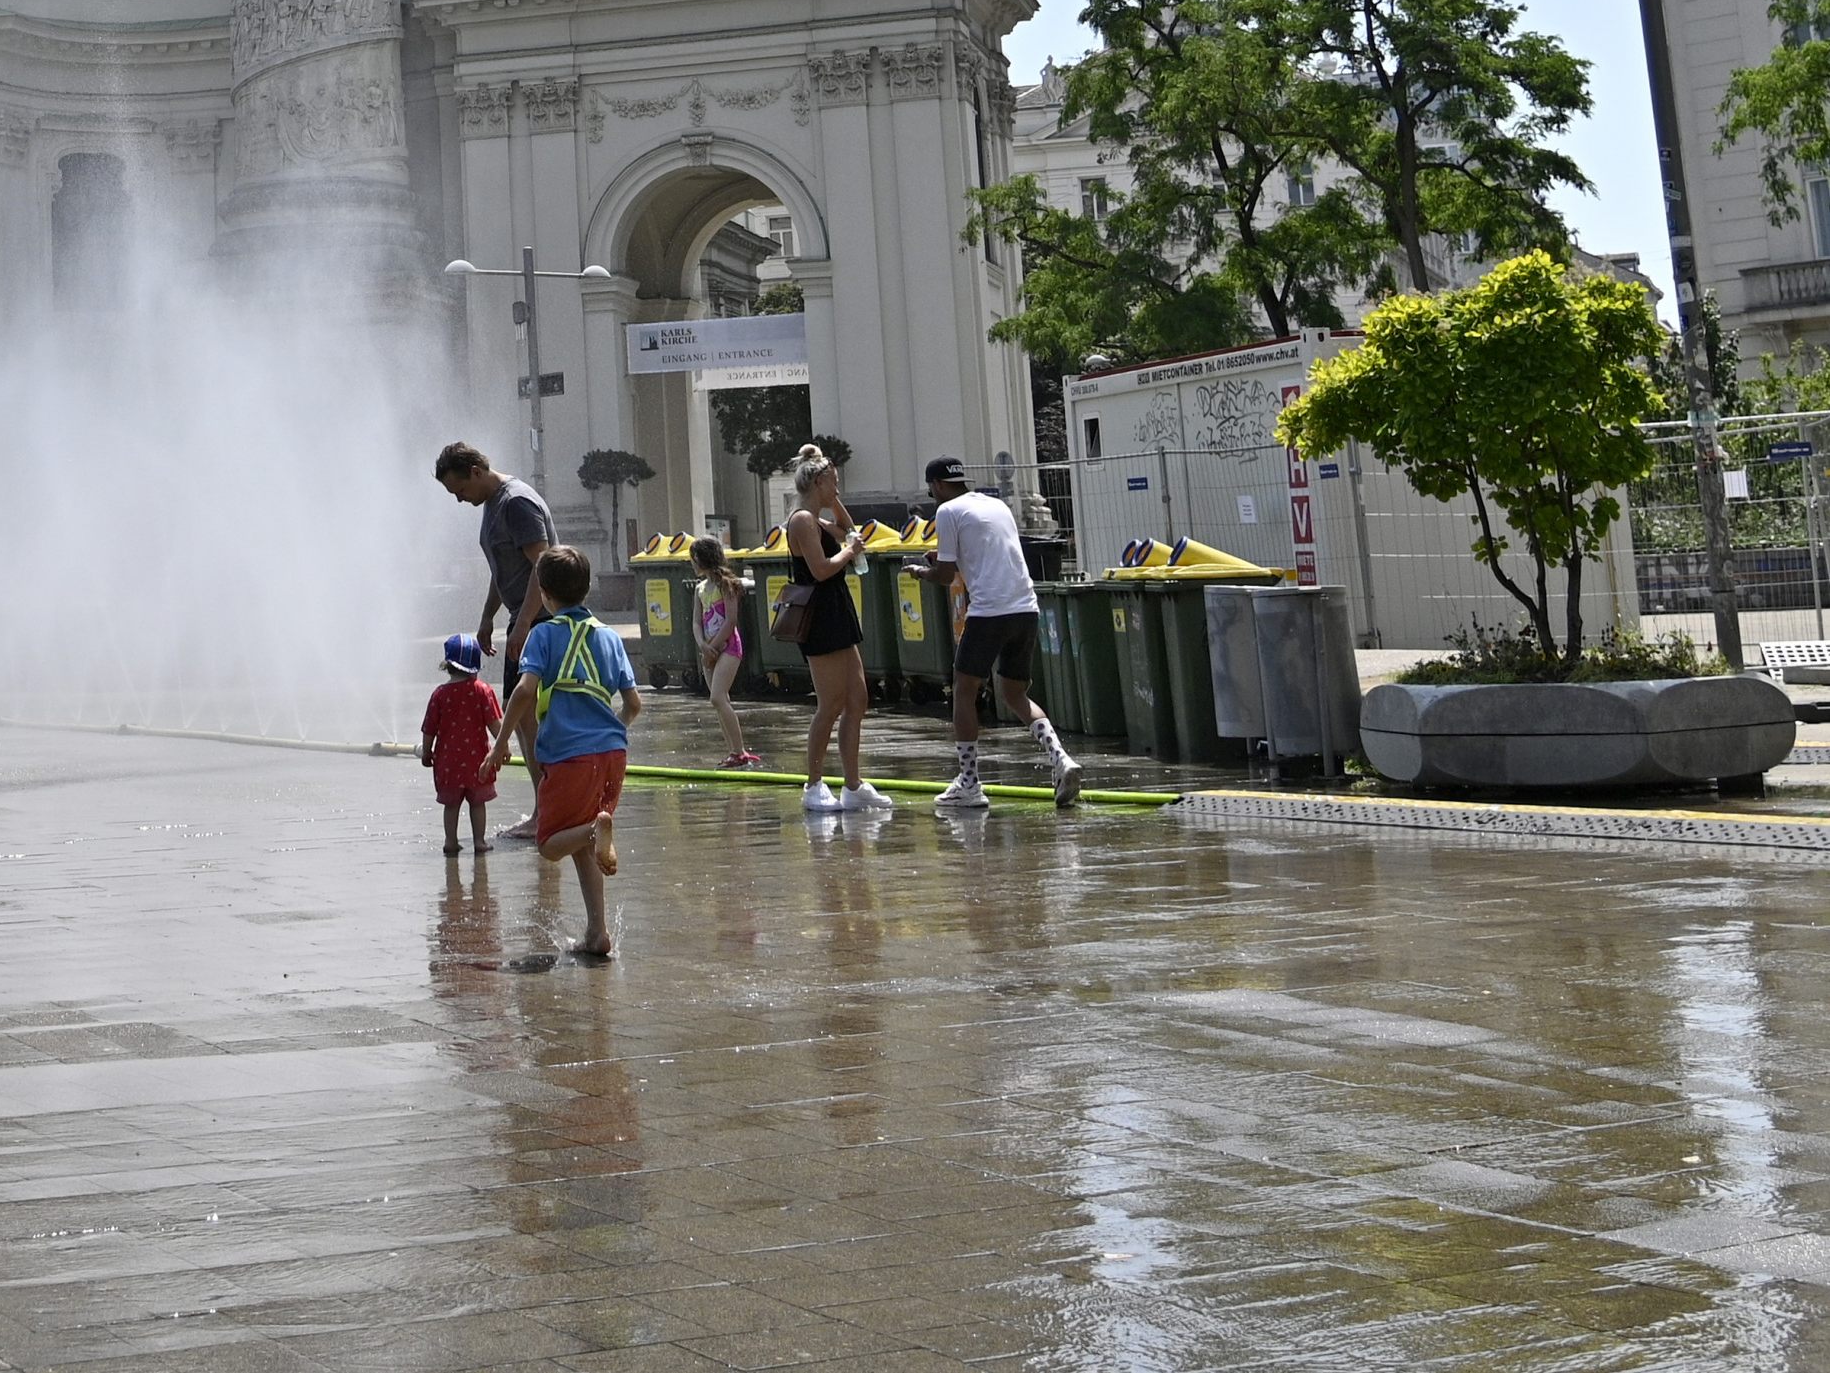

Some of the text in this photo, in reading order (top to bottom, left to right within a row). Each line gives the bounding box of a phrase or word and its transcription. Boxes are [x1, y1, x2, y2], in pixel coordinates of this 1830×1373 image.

[660, 328, 692, 337] KARLS
[661, 336, 698, 345] KIRCHE
[661, 348, 774, 364] EINGANG ENTRANCE
[1151, 363, 1203, 382] MIETCONTAINER
[1255, 346, 1299, 363] www.chv.at
